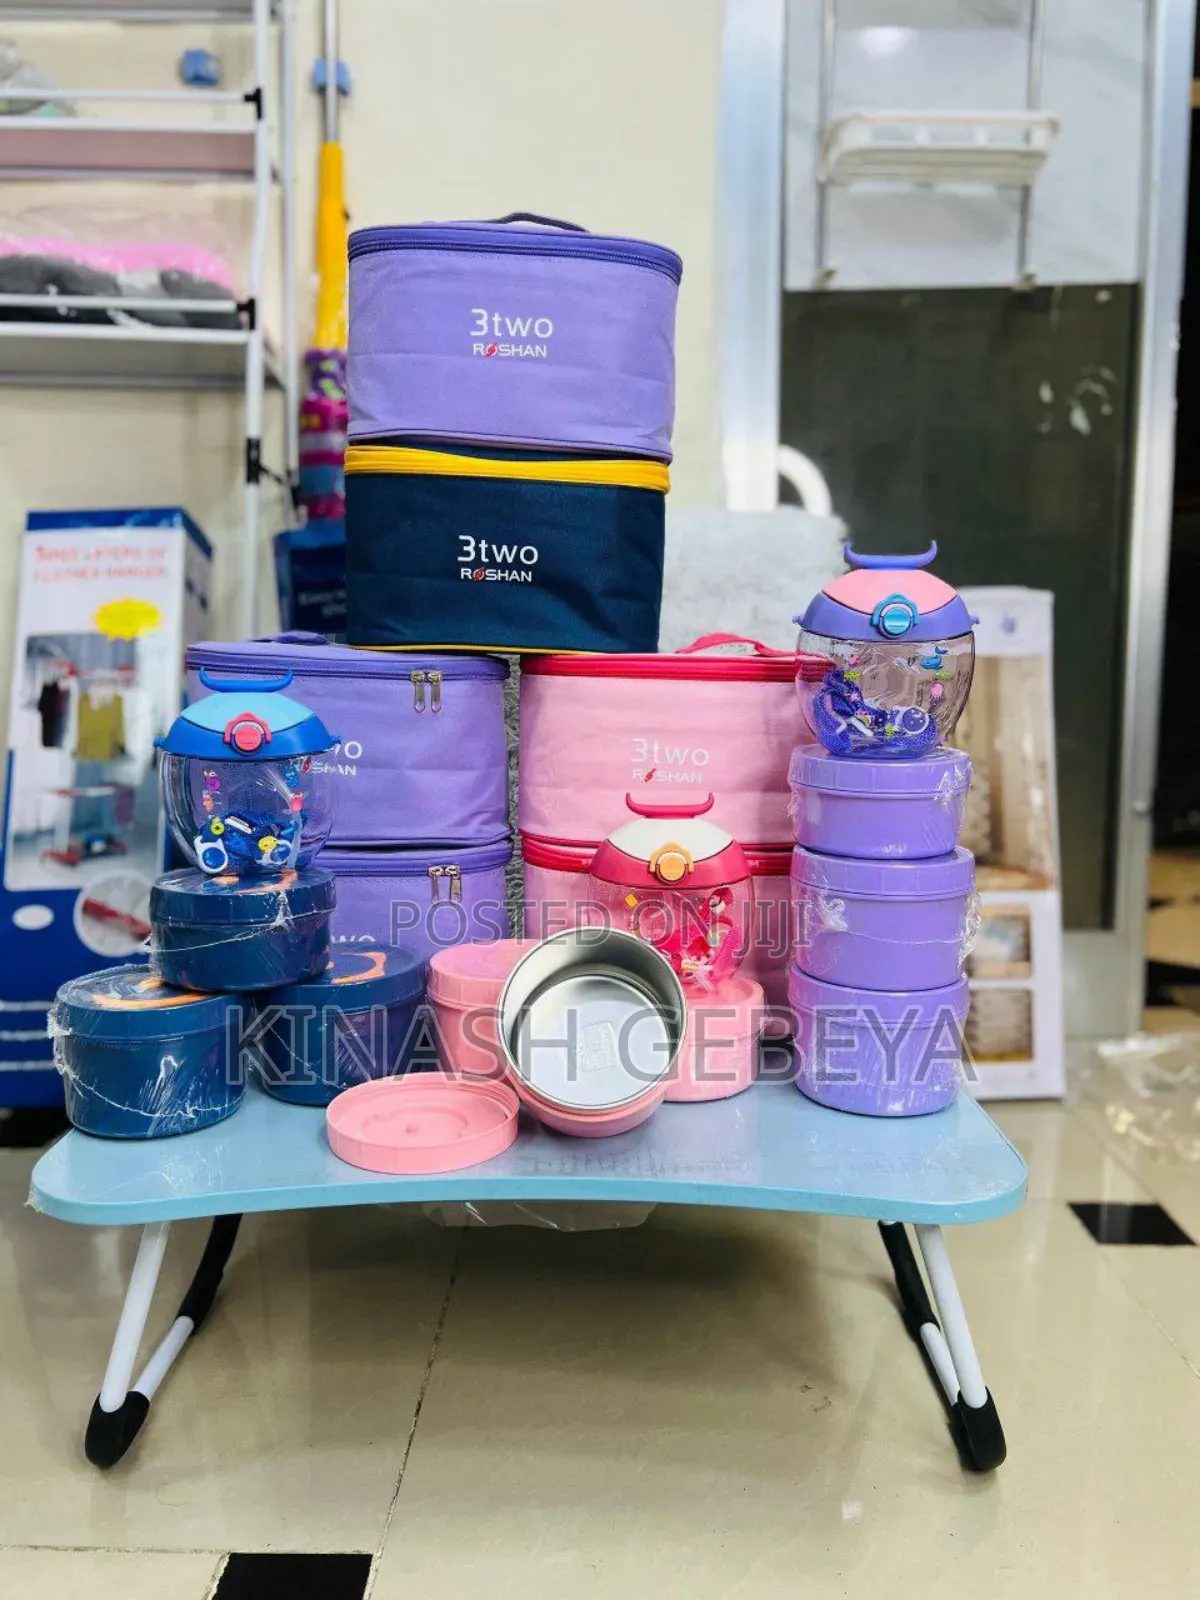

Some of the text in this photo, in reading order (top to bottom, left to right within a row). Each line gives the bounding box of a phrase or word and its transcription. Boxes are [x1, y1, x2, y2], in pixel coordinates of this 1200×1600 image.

[470, 308, 554, 338] 3two
[473, 341, 548, 358] ROSHAN
[457, 534, 539, 565] 3two
[460, 566, 533, 583] ROSHAN
[630, 738, 710, 767] 3two
[632, 768, 704, 785] ROSHAN
